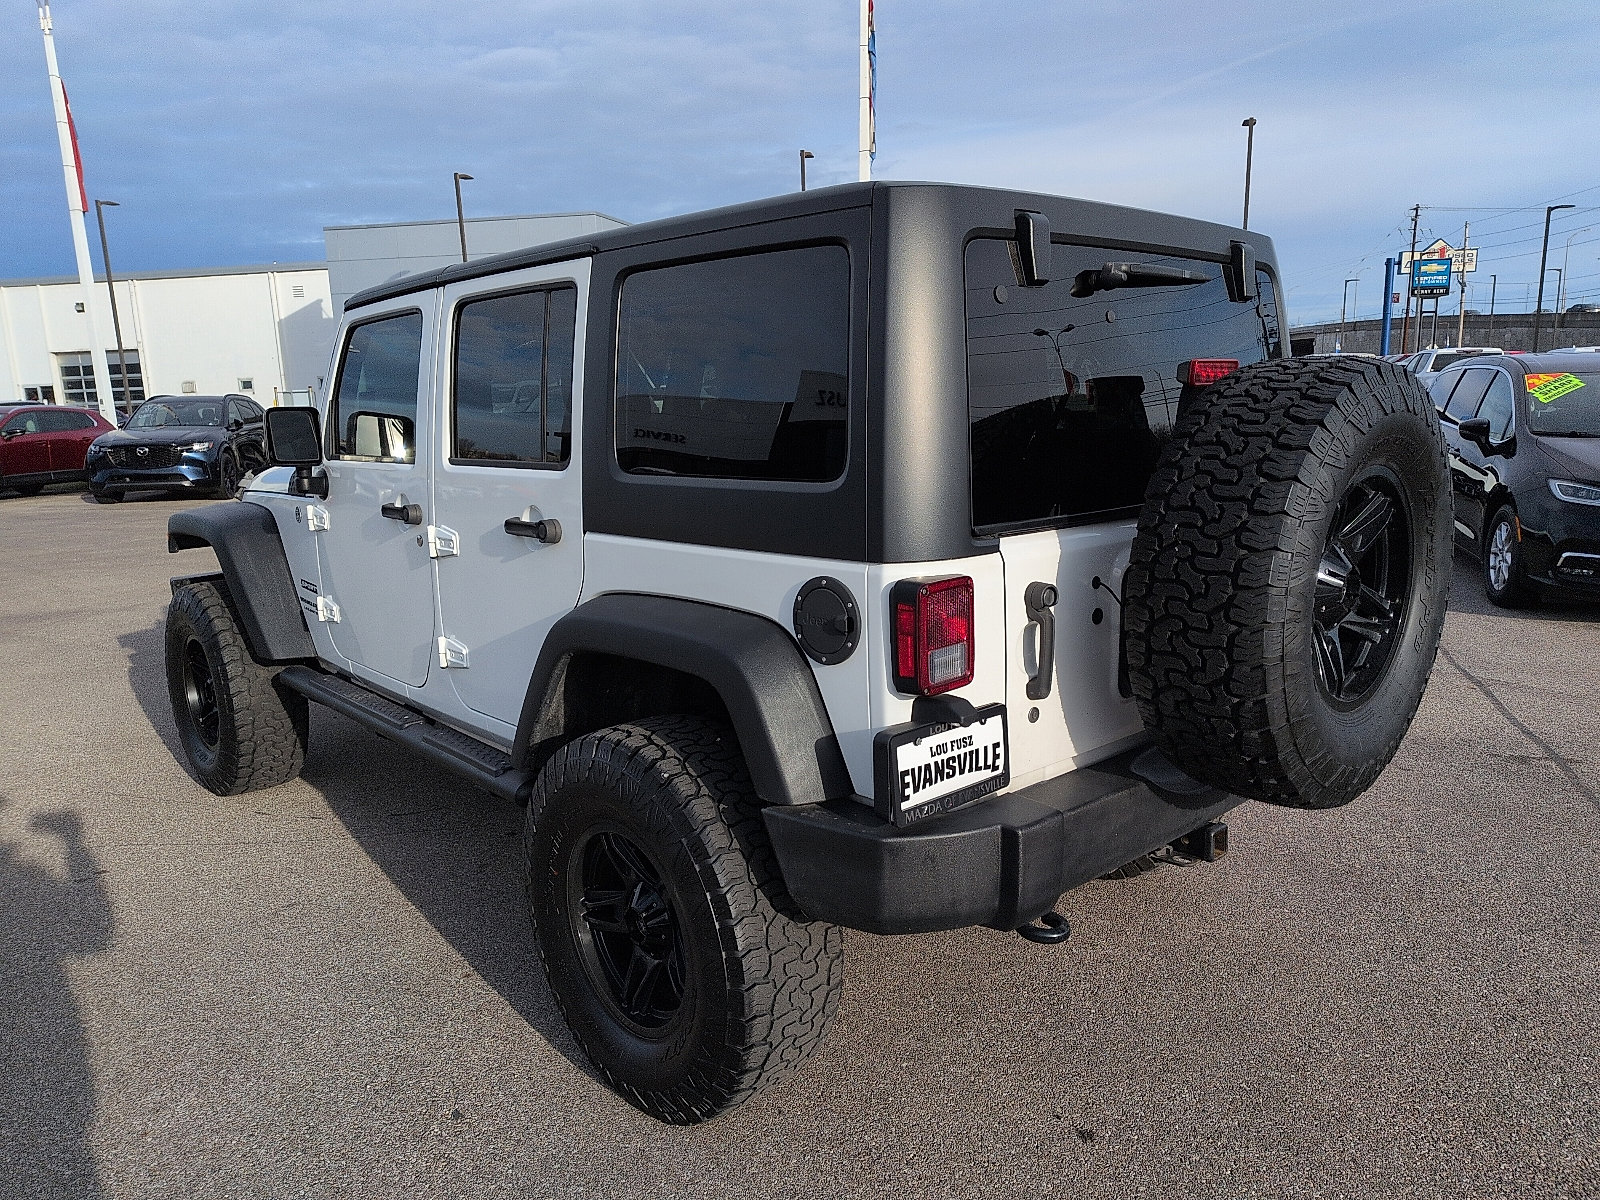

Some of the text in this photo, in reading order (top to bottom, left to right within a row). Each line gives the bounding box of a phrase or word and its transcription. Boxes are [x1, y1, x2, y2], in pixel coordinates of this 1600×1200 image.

[1533, 374, 1571, 393] LEATHER
[1539, 379, 1574, 396] SHARP
[930, 723, 948, 735] LOU
[930, 735, 974, 758] LOU FUSZ
[900, 741, 1001, 802] EVANSVILLE
[905, 777, 1005, 824] MAZDA OF EVANSVILLE
